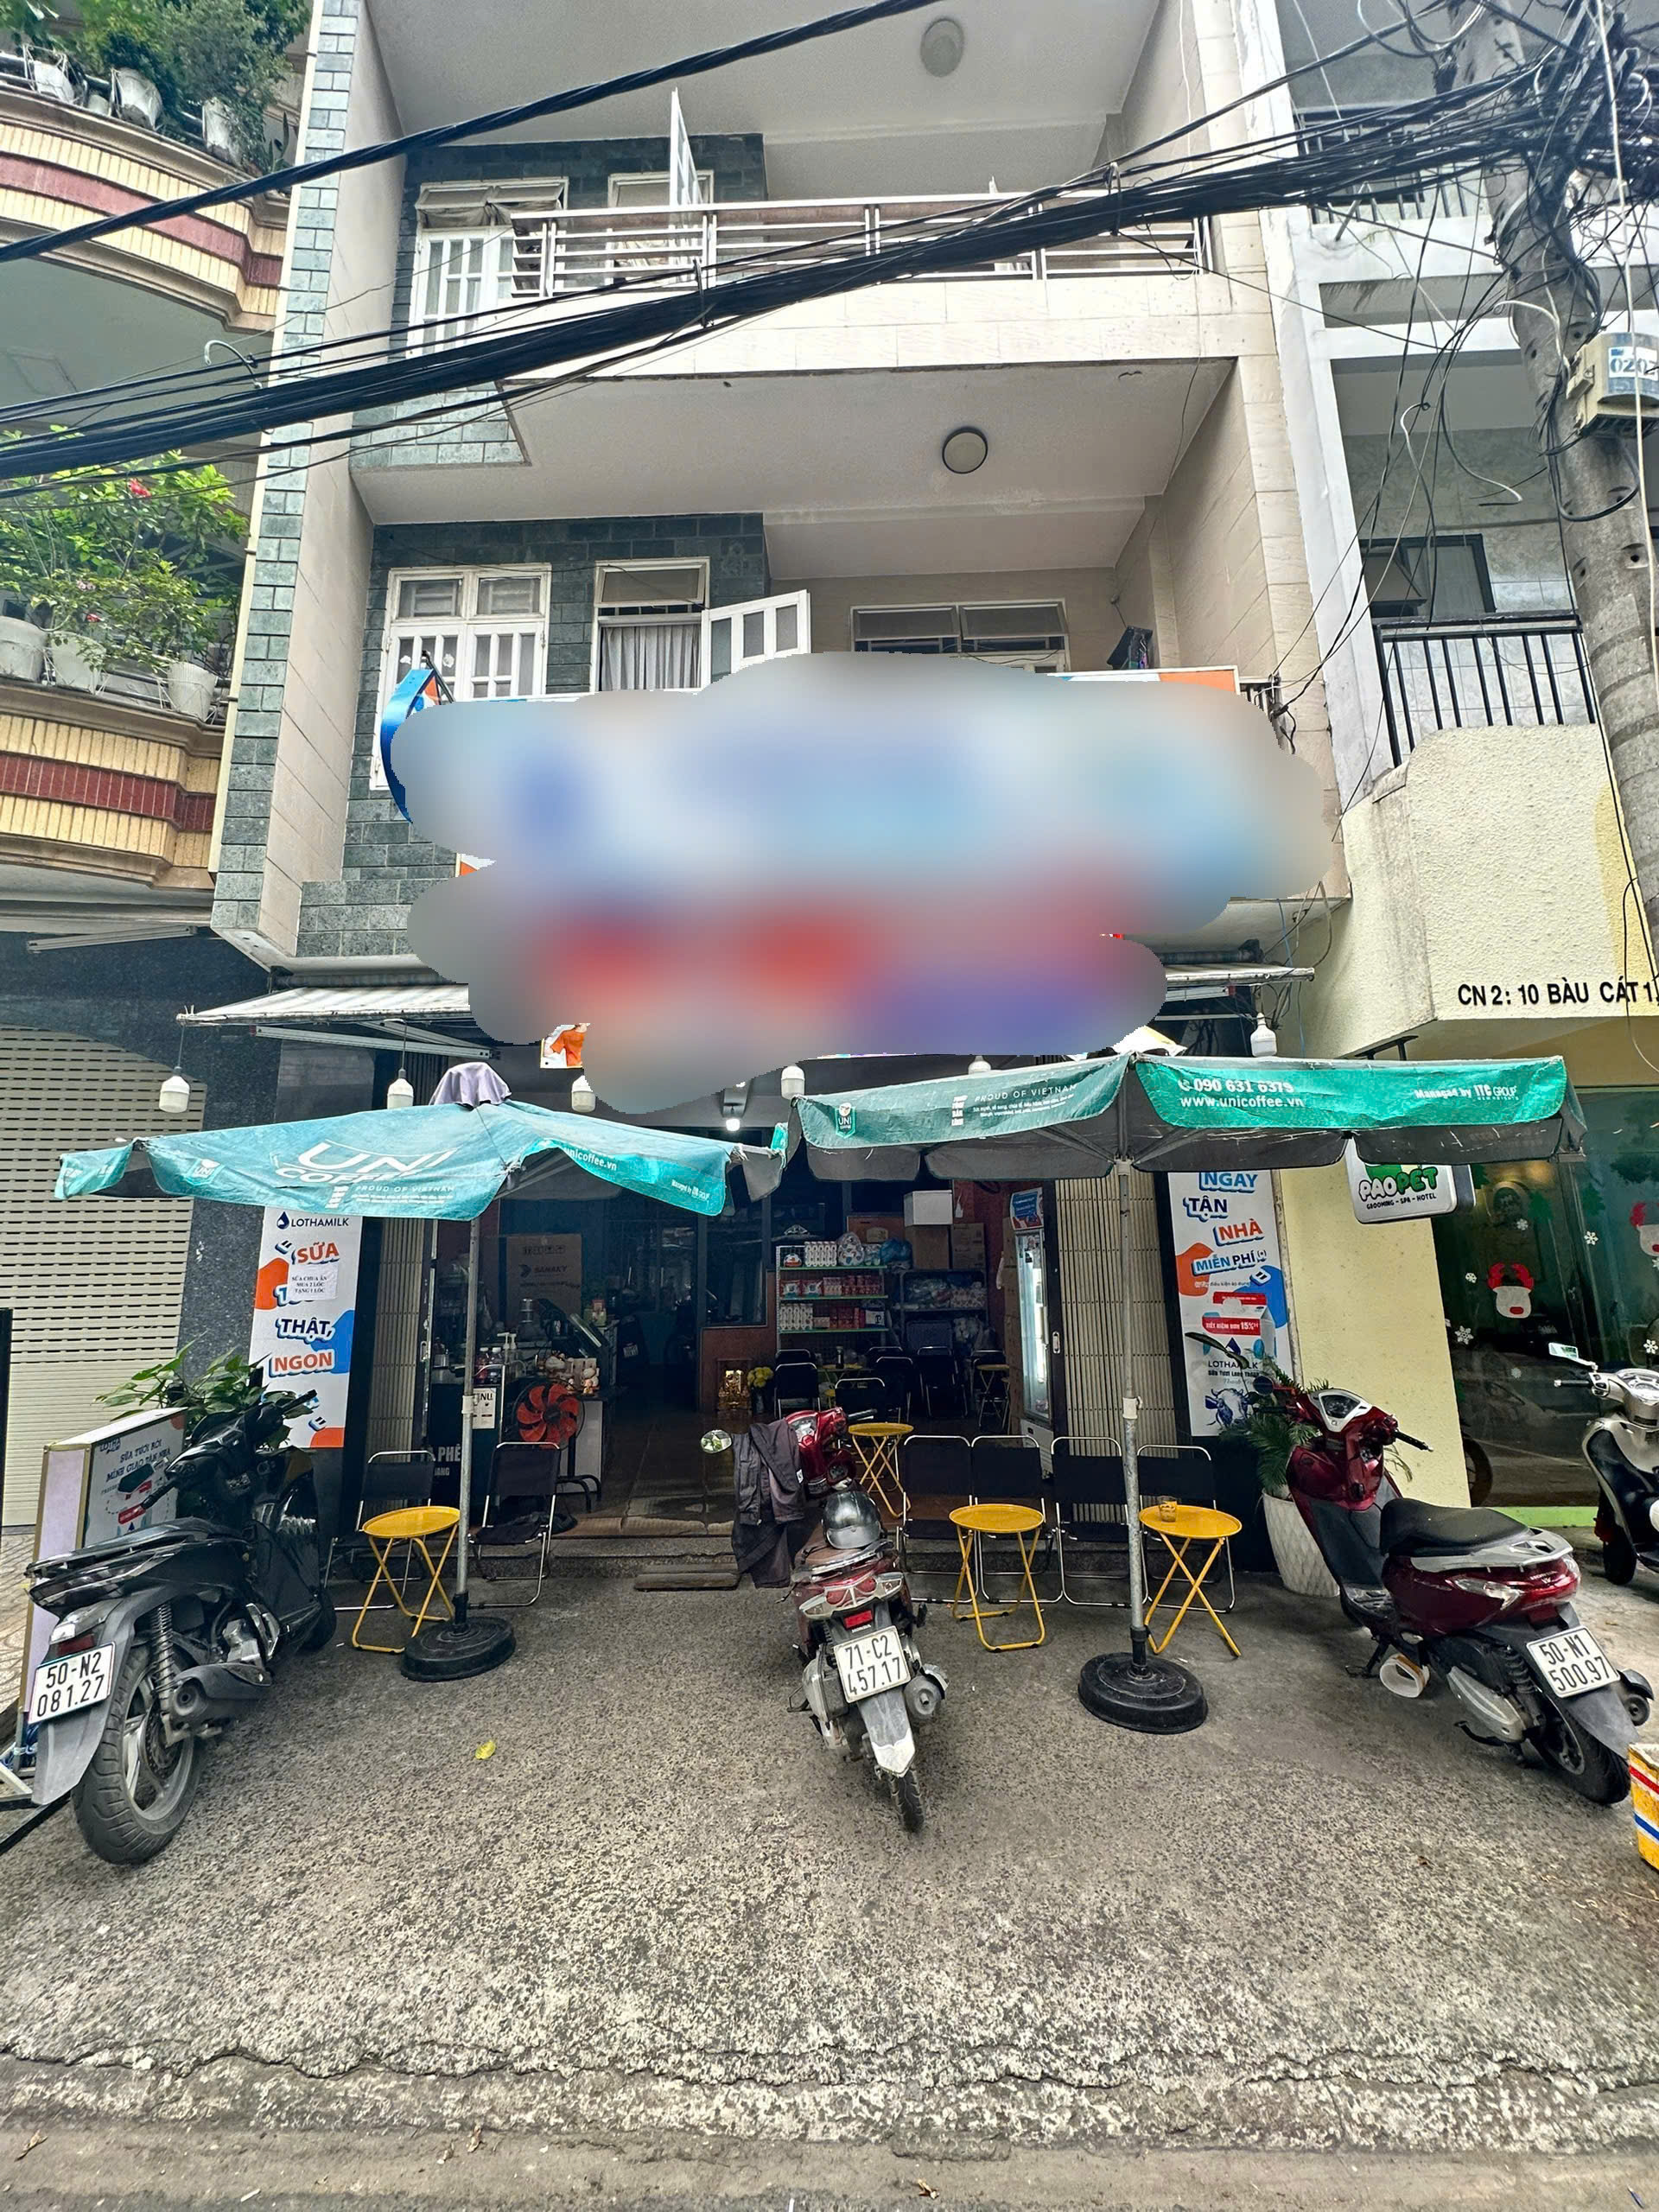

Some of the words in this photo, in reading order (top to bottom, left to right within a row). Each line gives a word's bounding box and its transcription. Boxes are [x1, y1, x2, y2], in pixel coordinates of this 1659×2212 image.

[1458, 983, 1487, 1006] CN
[1491, 985, 1511, 1005] 2:
[1517, 984, 1540, 1005] 10
[1547, 976, 1590, 1005] BÀU
[1599, 976, 1638, 1003] CÁT
[1194, 1078, 1223, 1092] 090
[1226, 1079, 1254, 1092] 631
[974, 1092, 1008, 1103] PROUD
[1180, 1096, 1306, 1107] www.unicoffee.vn
[838, 1116, 852, 1125] UNI
[298, 1142, 459, 1173] UNI
[1204, 1172, 1258, 1188] NGAY
[1358, 1166, 1439, 1202] PAOPET
[1188, 1195, 1228, 1217] TẬN
[1417, 1192, 1437, 1201] HOTEL
[291, 1217, 349, 1227] LOTHAMILK
[1218, 1217, 1263, 1241] NHÀ
[296, 1242, 340, 1263] SỮA
[1196, 1253, 1230, 1271] MIỄN
[1232, 1249, 1255, 1265] PHÍ
[281, 1316, 333, 1339] THẬT,
[275, 1352, 333, 1372] NGON
[1539, 1634, 1591, 1665] 50-N1
[46, 1651, 102, 1688] 50-N2
[848, 1656, 900, 1695] 457.17
[1548, 1656, 1610, 1691] 500.97
[37, 1674, 105, 1717] 081.27
